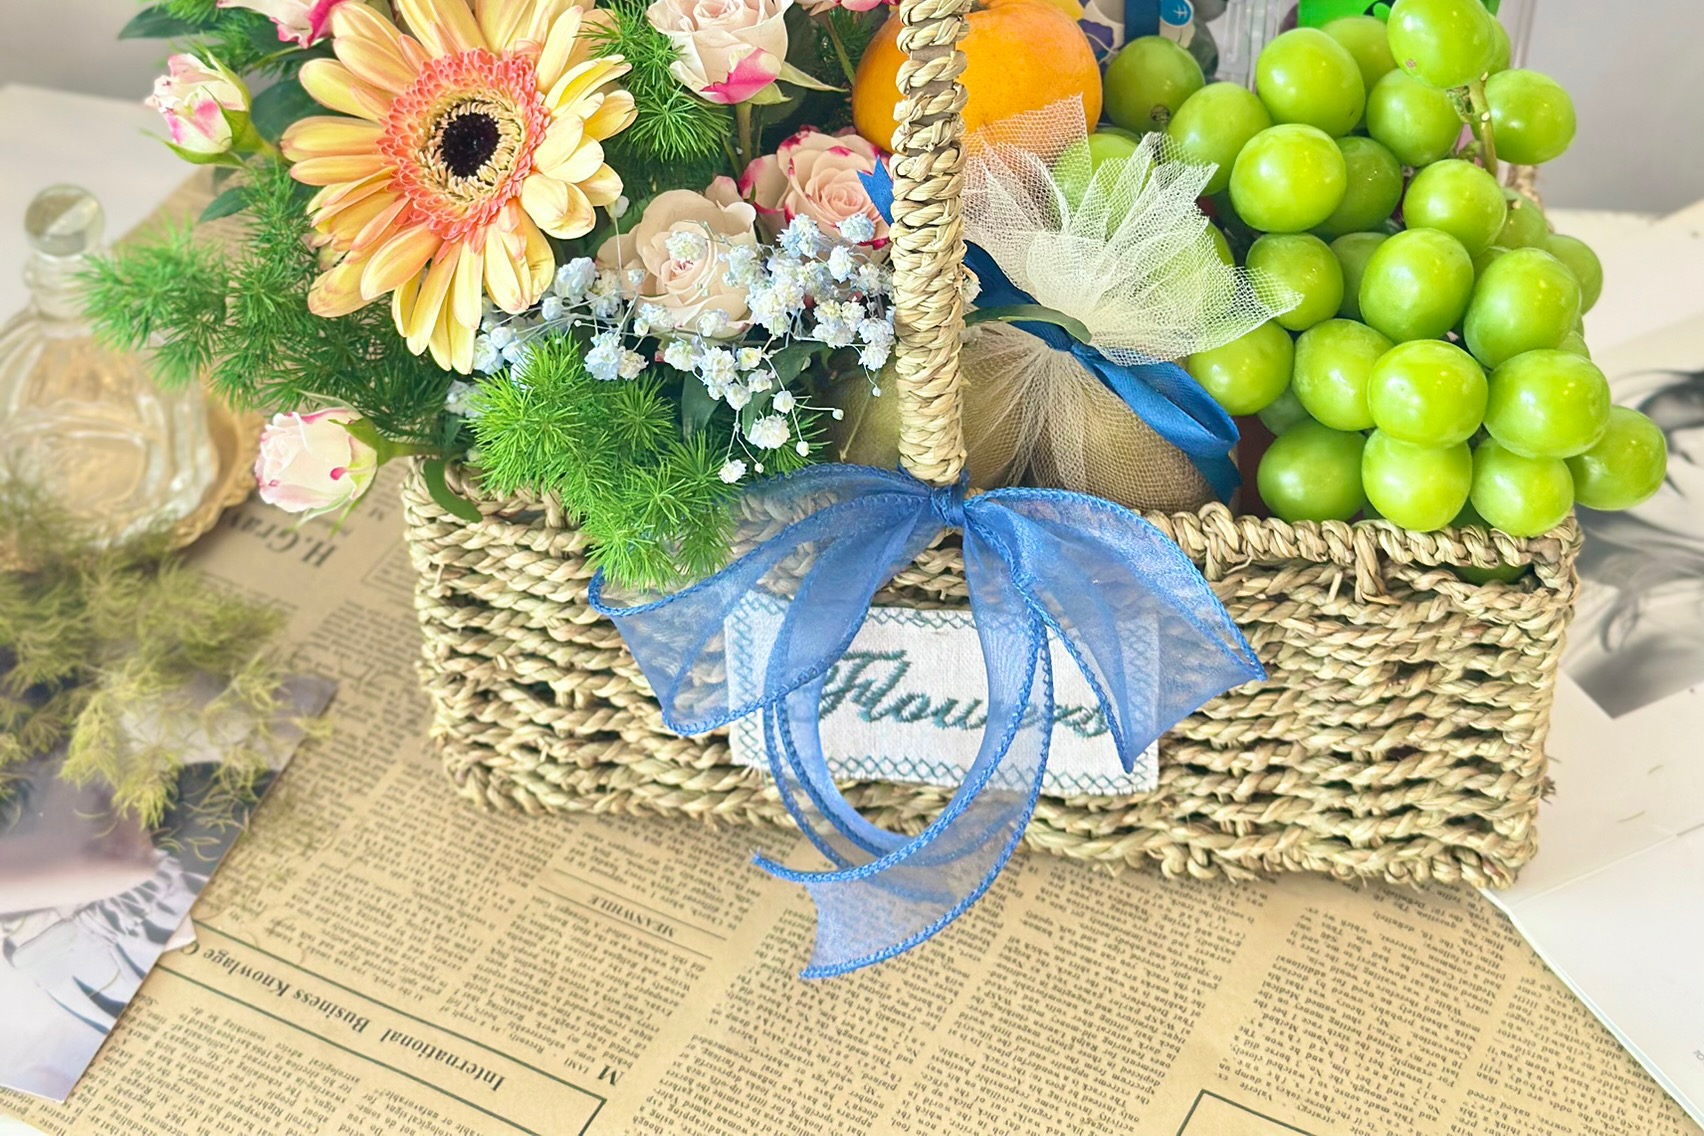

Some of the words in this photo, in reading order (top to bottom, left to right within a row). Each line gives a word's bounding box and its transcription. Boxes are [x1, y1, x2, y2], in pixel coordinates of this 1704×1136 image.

[588, 894, 676, 937] MEANWHILE
[202, 948, 291, 997] Knowlage
[292, 989, 371, 1033] Business
[958, 1011, 985, 1026] world
[989, 1023, 1012, 1039] little
[1014, 1034, 1060, 1056] repressed
[379, 1028, 505, 1091] International
[930, 1054, 971, 1077] business
[1063, 1053, 1080, 1065] the
[685, 1065, 706, 1078] such
[926, 1062, 943, 1075] way
[946, 1071, 961, 1084] his
[980, 1063, 1025, 1086] Accounts
[1083, 1061, 1108, 1077] from
[658, 1078, 694, 1096] gathers
[665, 1069, 695, 1088] horses
[695, 1081, 711, 1093] the
[709, 1074, 743, 1095] tip-offs
[810, 1072, 829, 1087] legs
[974, 1072, 1030, 1099] responsible
[1111, 1072, 1155, 1096] spectrum
[111, 1083, 157, 1112] biography
[953, 1086, 970, 1098] the
[979, 1085, 1015, 1104] civilian
[1028, 1083, 1043, 1096] his
[693, 1092, 713, 1106] that
[712, 1088, 750, 1110] examine
[745, 1092, 768, 1108] little
[847, 1090, 885, 1110] number
[989, 1101, 1007, 1113] out
[1034, 1097, 1060, 1112] some
[1046, 1089, 1093, 1116] involving
[681, 1099, 714, 1118] named
[713, 1101, 743, 1119] crowd
[769, 1103, 786, 1115] for
[1016, 1101, 1053, 1120] regular
[164, 1110, 188, 1127] 1965
[716, 1115, 748, 1135] woman
[744, 1115, 760, 1128] the
[763, 1111, 784, 1126] area
[788, 1109, 823, 1133] looking
[1012, 1110, 1041, 1128] walks
[1078, 1116, 1114, 1135] engage
[1094, 1111, 1135, 1133] activity
[1065, 1122, 1085, 1136] like
